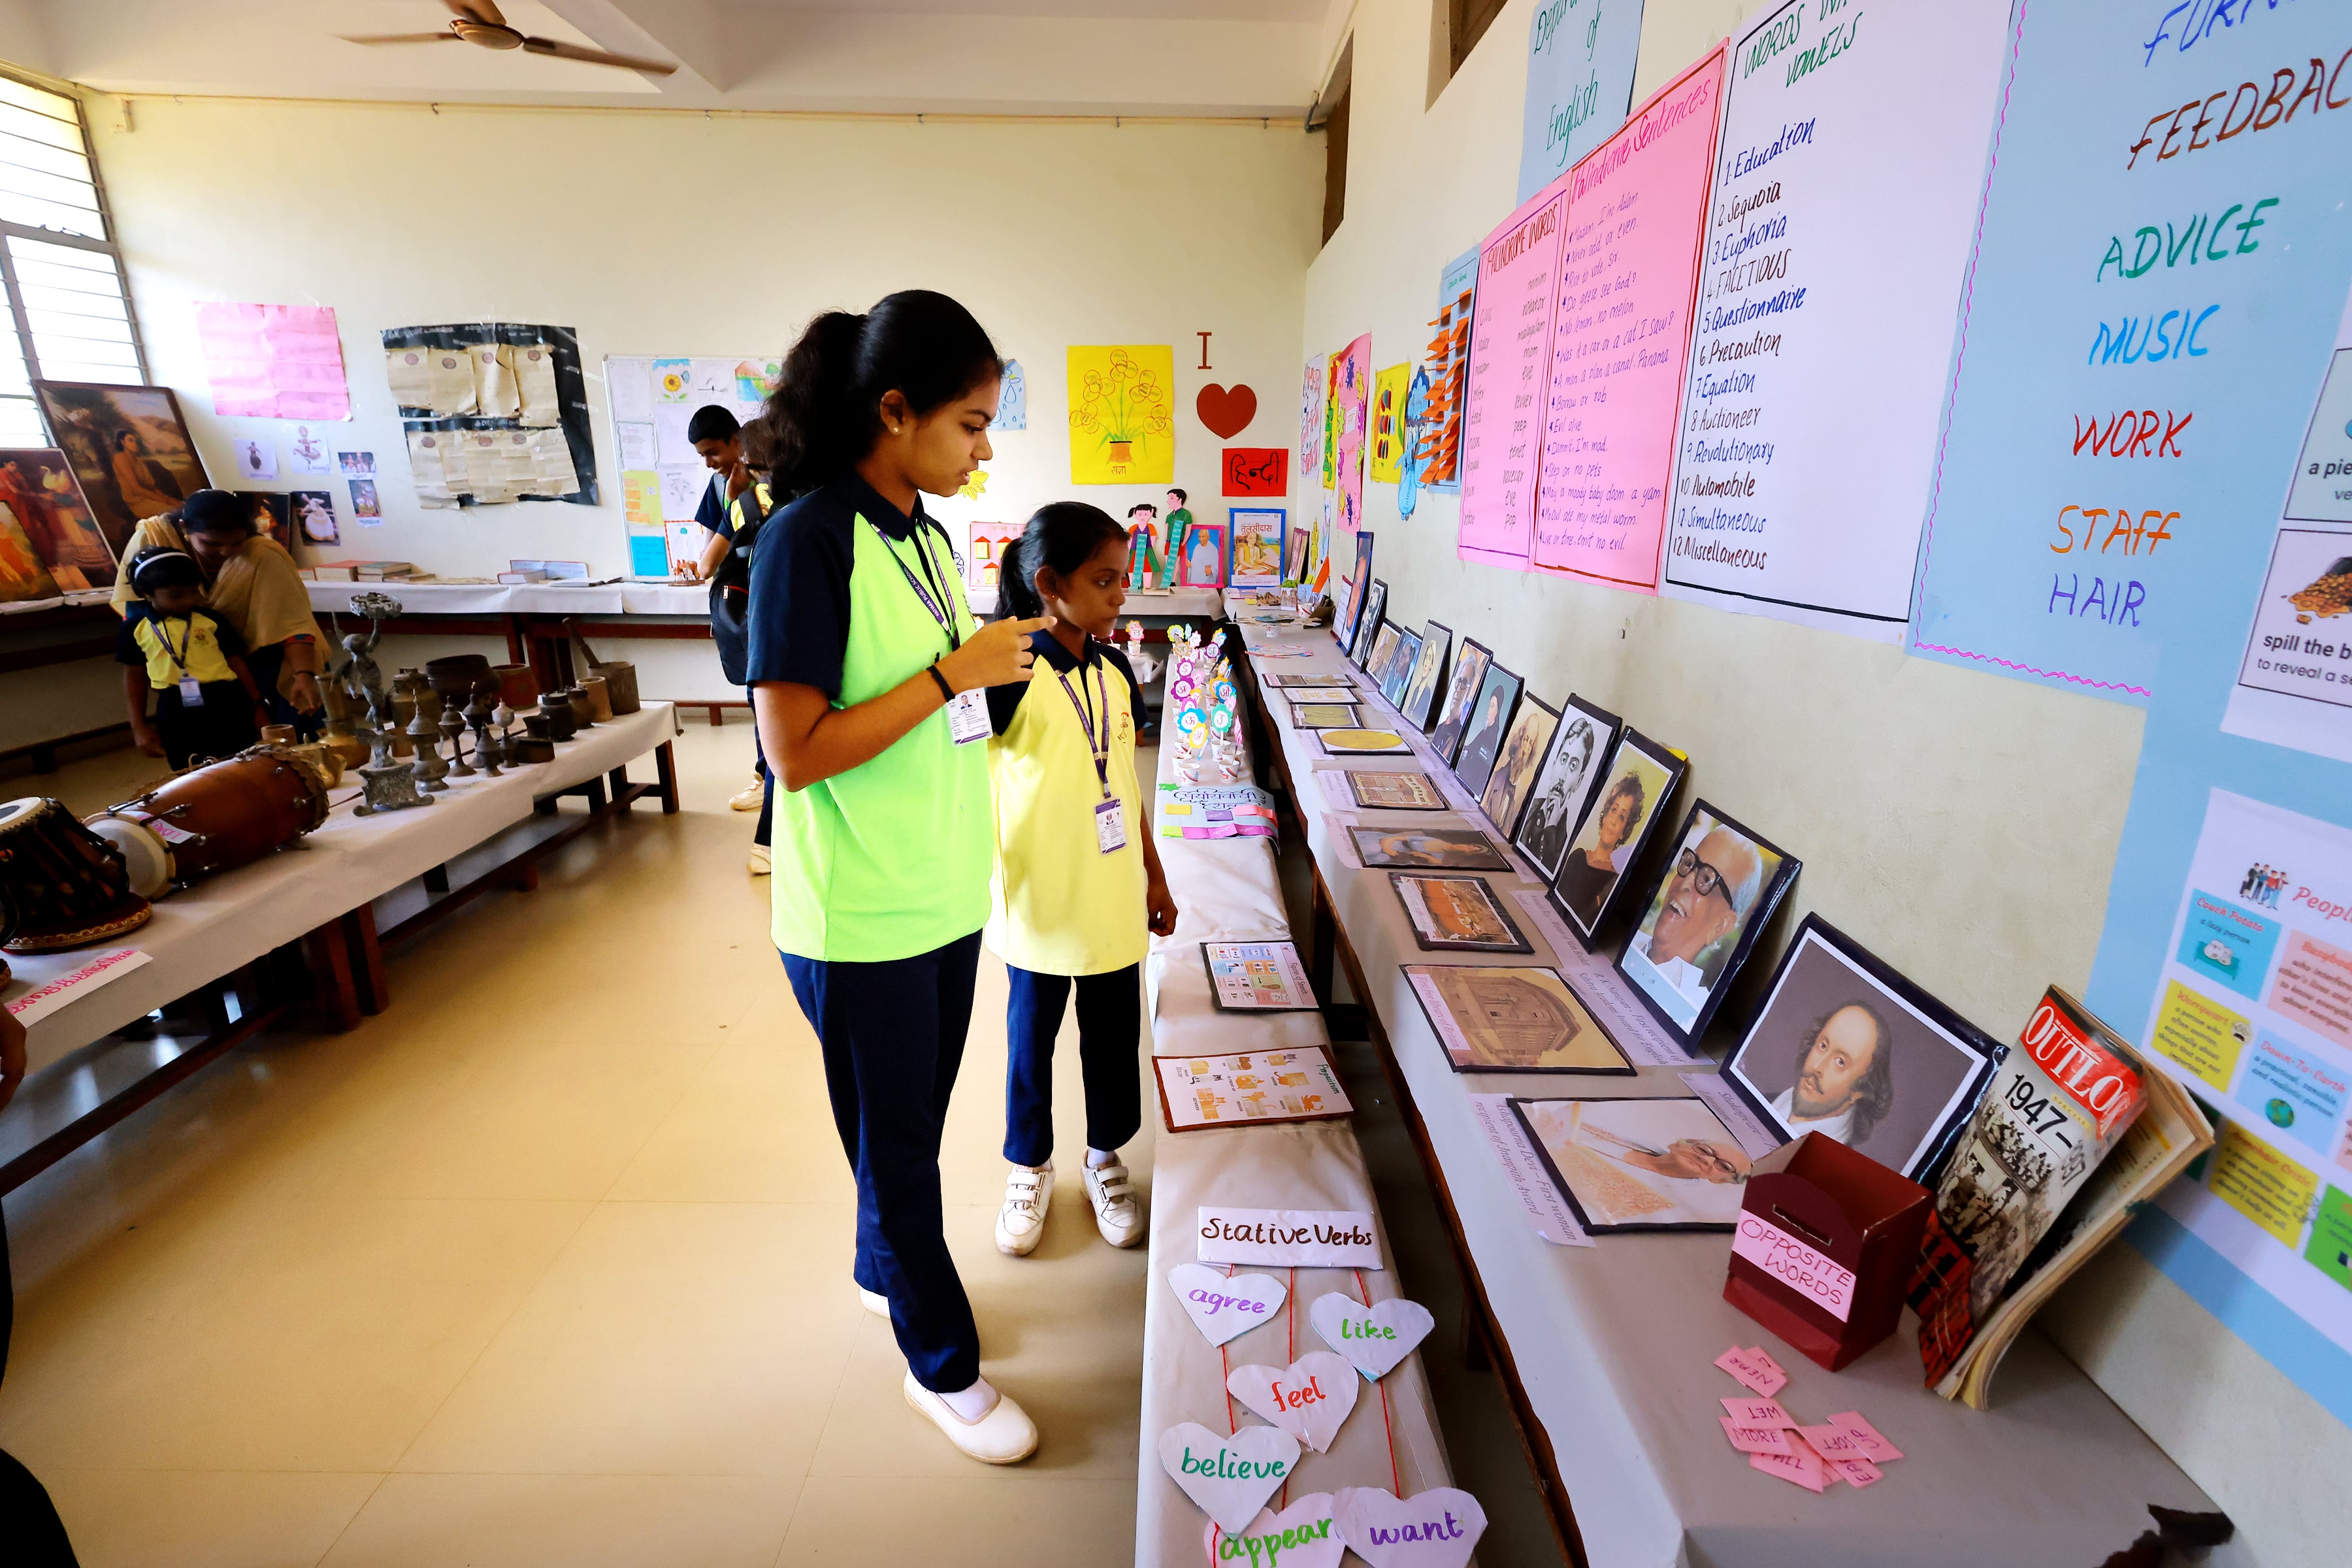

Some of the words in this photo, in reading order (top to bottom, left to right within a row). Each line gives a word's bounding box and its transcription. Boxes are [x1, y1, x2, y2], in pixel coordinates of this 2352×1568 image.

[1587, 0, 1601, 61] of
[1744, 3, 1805, 79] WORDS
[1786, 12, 1863, 88] VOWELS
[1546, 68, 1598, 167] English
[1572, 142, 1631, 204] Palindrome
[1633, 78, 1712, 152] Sentences
[1485, 224, 1527, 280] PALINDROME
[1528, 203, 1558, 250] WORDS
[1589, 233, 1602, 257] odd
[1605, 230, 1614, 246] or
[2097, 198, 2279, 282] ADVICE
[1566, 295, 1576, 312] Do
[1579, 287, 1597, 310] geese
[1600, 282, 1612, 298] see
[1597, 309, 1607, 323] no
[1609, 297, 1634, 319] melon
[1582, 344, 1588, 357] a
[1589, 340, 1600, 354] car
[1602, 338, 1610, 351] or
[1612, 335, 1620, 350] a
[1623, 319, 1639, 346] cat
[1639, 318, 1648, 340] I
[2089, 305, 2220, 365] MUSIC
[1197, 332, 1212, 369] I
[1524, 346, 1538, 359] mom
[1522, 365, 1533, 389] eye
[1556, 395, 1576, 411] Borrow
[1580, 395, 1588, 406] or
[1593, 385, 1607, 402] rob
[1513, 420, 1527, 438] peep
[1554, 418, 1565, 433] Evil
[2073, 410, 2192, 457] WORK
[1509, 440, 1526, 459] tenet
[1575, 437, 1589, 452] I'm
[1229, 451, 1280, 490] हिन्दी
[1548, 463, 1560, 484] Step
[1562, 466, 1570, 478] on
[1575, 464, 1583, 475] no
[1584, 461, 1602, 483] pets
[2309, 462, 2319, 476] a
[1505, 490, 1516, 507] eve
[1560, 487, 1565, 497] a
[1568, 485, 1586, 506] moody
[1589, 484, 1604, 507] baby
[1606, 482, 1625, 501] doom
[1631, 489, 1637, 500] a
[1241, 523, 1272, 535] तुलसीदास
[1504, 514, 1516, 532] pop
[1563, 508, 1574, 523] ate
[1577, 512, 1588, 529] my
[1590, 509, 1612, 525] metal
[2050, 505, 2180, 555] STAFF
[1553, 534, 1560, 545] on
[1577, 531, 1594, 547] emit
[1595, 537, 1606, 549] no
[915, 583, 928, 602] PUBLIC
[2049, 574, 2145, 627] HAIR
[926, 600, 940, 617] FATIMA
[2263, 634, 2300, 653] spill
[2304, 638, 2334, 657] the
[2258, 659, 2270, 670] to
[2276, 660, 2321, 679] reveal
[2326, 672, 2336, 681] a
[2292, 887, 2352, 923] Peopl
[1476, 1102, 1499, 1136] recipient
[1537, 1181, 1556, 1202] First
[1551, 1205, 1576, 1240] woman
[1201, 1218, 1308, 1244] Stative
[1315, 1224, 1372, 1245] Verbs
[1742, 1220, 1852, 1287] OPPOSITE
[1765, 1253, 1842, 1304] WORDS
[1188, 1287, 1265, 1315] agree
[1342, 1318, 1397, 1340] like
[1729, 1358, 1773, 1385] NEAR
[1272, 1376, 1326, 1413] feel
[1748, 1407, 1781, 1419] WET
[1731, 1428, 1781, 1443] MORE
[1823, 1435, 1857, 1450] SOFT
[1181, 1447, 1286, 1478] believe
[1370, 1511, 1464, 1546] want
[1219, 1518, 1332, 1568] appear
